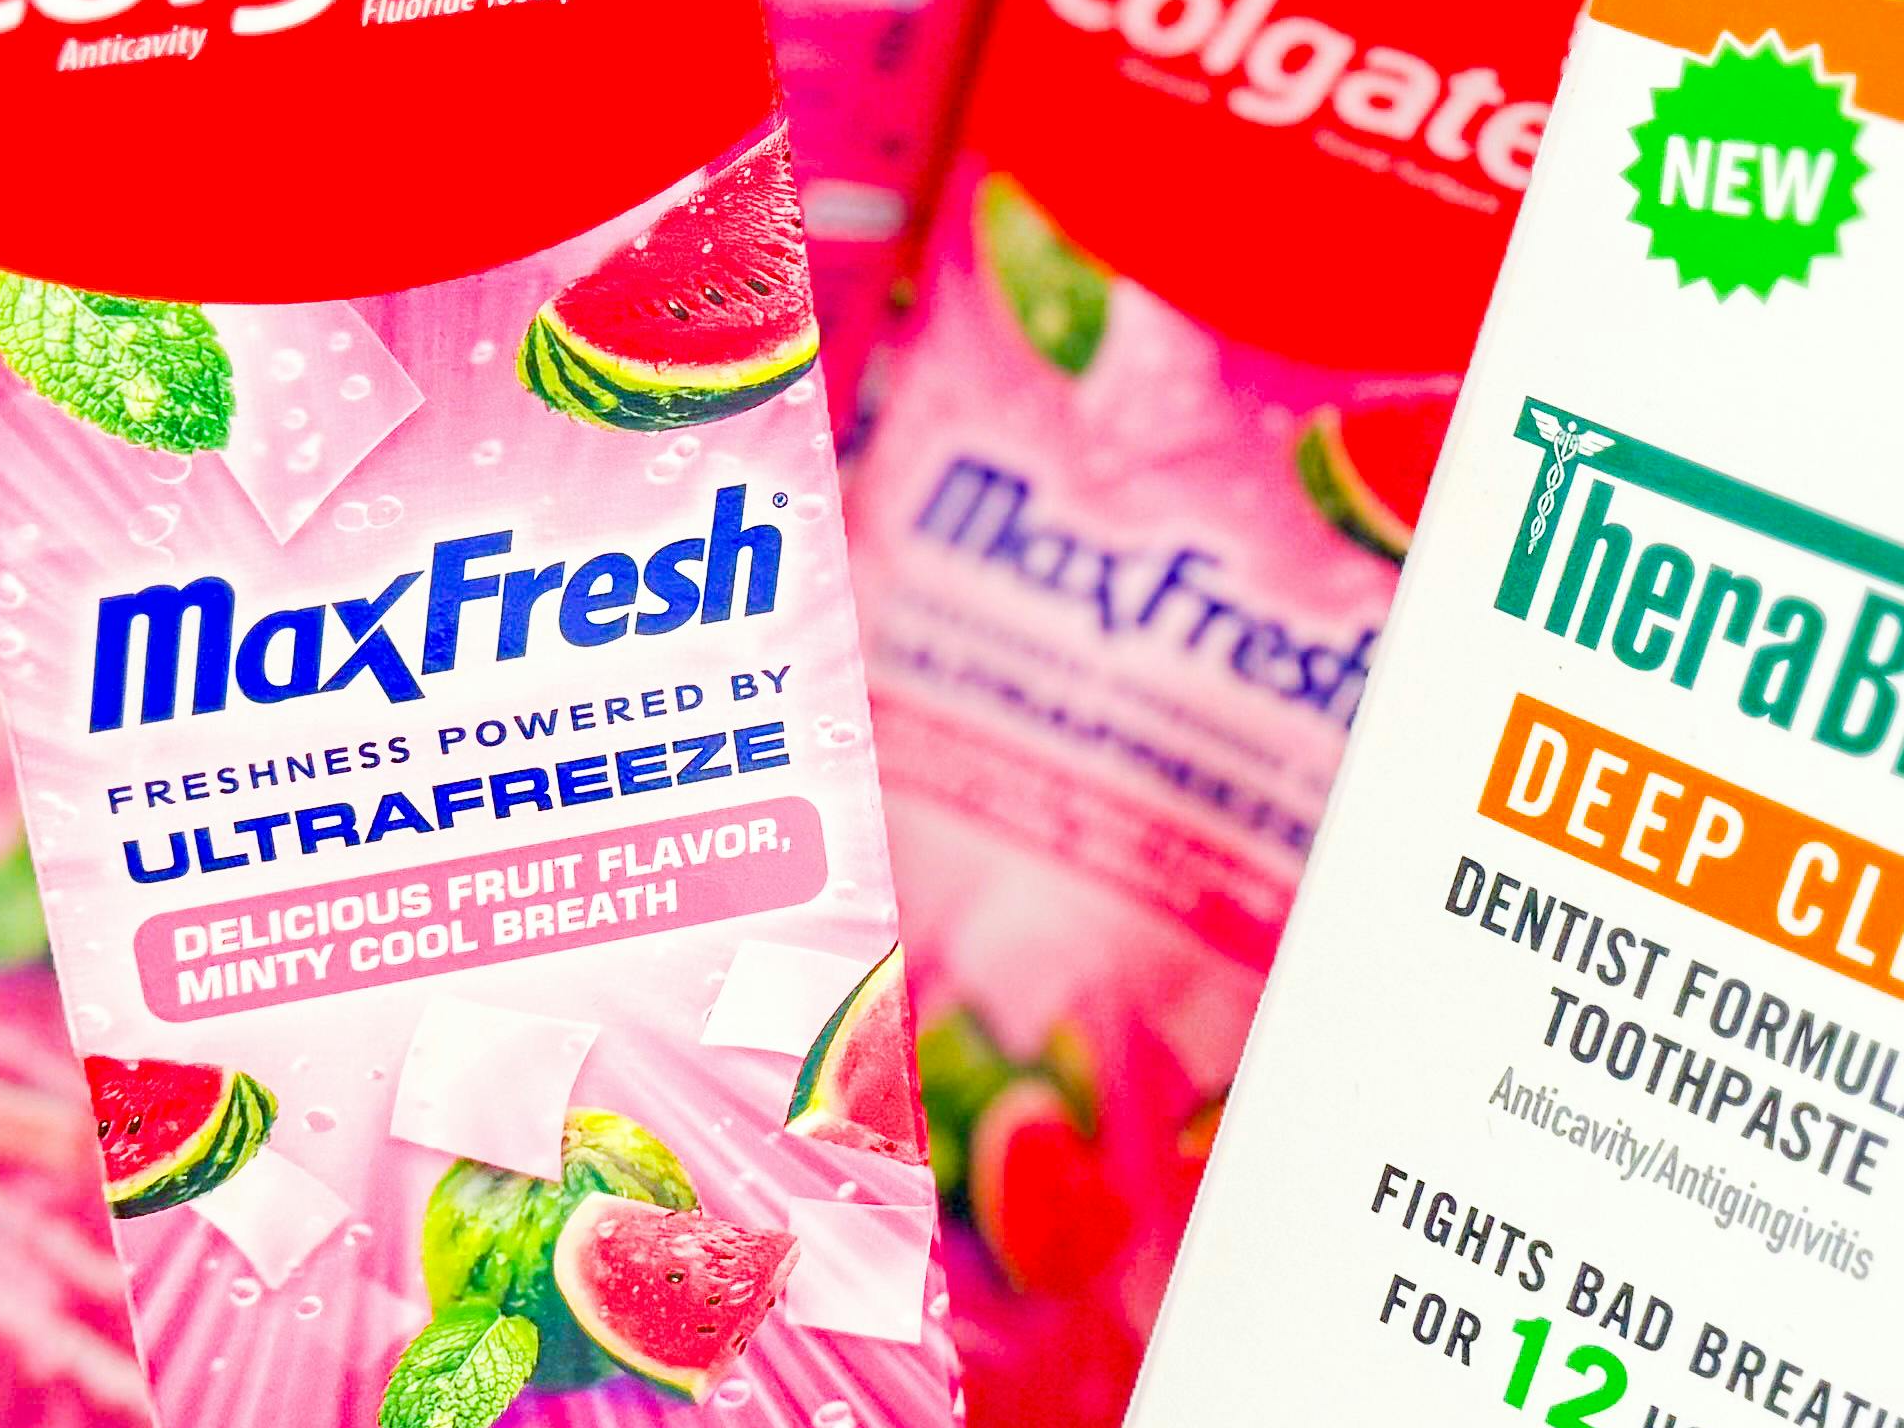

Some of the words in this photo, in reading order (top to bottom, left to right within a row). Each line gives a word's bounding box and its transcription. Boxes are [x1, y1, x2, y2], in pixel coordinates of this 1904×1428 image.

[59, 26, 207, 71] Anticavity
[1659, 135, 1833, 222] NEW
[88, 484, 782, 733] MaxFresh
[107, 736, 411, 814] FRESHNESS
[439, 683, 704, 755] POWERED
[731, 665, 792, 701] BY
[122, 721, 790, 884] ULTRAFREEZE
[1506, 721, 1744, 886] DEEP
[175, 883, 432, 962] DELICIOUS
[447, 852, 588, 907] FRUIT
[597, 817, 790, 882] FLAVOR,
[179, 946, 340, 1004] MINTY
[350, 920, 476, 972] COOL
[494, 880, 676, 946] BREATH
[1445, 855, 1671, 1001] DENTIST
[1543, 987, 1889, 1196] TOOTHPASTE
[1489, 1068, 1874, 1281] Anticavity/Antigingivitis
[1370, 1164, 1553, 1293] FIGHTS
[1566, 1262, 1674, 1353] BAD
[1380, 1274, 1481, 1366] FOR
